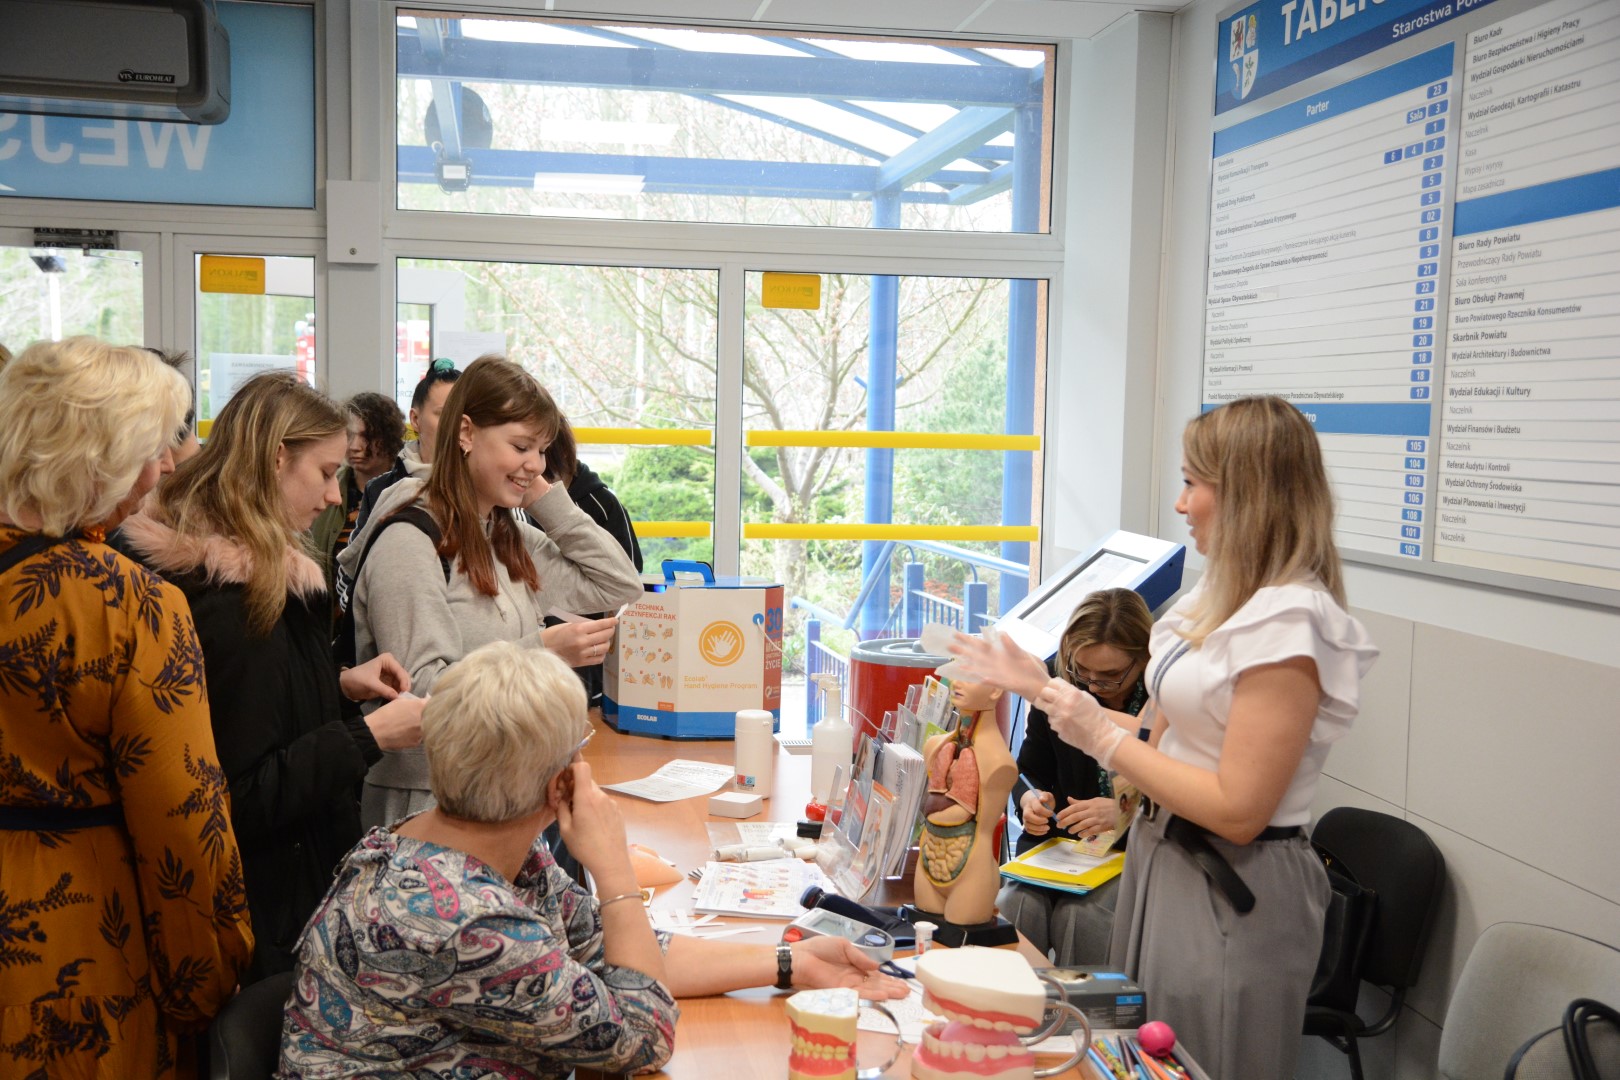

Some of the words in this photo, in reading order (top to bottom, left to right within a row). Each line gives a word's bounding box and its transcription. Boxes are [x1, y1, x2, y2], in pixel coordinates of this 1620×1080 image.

[1392, 4, 1452, 38] Starostwa
[1472, 52, 1487, 64] Biuro
[1488, 35, 1533, 58] Bezpieczeństwa
[1537, 25, 1561, 41] Higieny
[1562, 18, 1580, 31] Pracy
[1473, 33, 1488, 45] Biuro
[1489, 27, 1503, 39] Kadr
[1470, 67, 1491, 83] Wydział
[1492, 55, 1526, 74] Gospodarki
[1433, 85, 1442, 96] 23
[1467, 107, 1489, 121] Wydział
[1517, 87, 1550, 105] Kartografii
[1553, 79, 1581, 94] Katastru
[1306, 100, 1329, 117] Parter
[1409, 110, 1424, 122] Sala
[1433, 140, 1438, 149] 7
[1427, 211, 1435, 221] 02
[1458, 241, 1474, 251] Biuro
[1476, 238, 1491, 249] Rady
[1493, 233, 1520, 245] Powiatu
[1501, 252, 1516, 262] Rady
[1517, 249, 1541, 260] Powiatu
[1424, 265, 1431, 275] 21
[1421, 283, 1429, 292] 22
[1455, 296, 1470, 306] Biuro
[1472, 292, 1496, 304] Obsługi
[1497, 289, 1525, 300] Prawnej
[1421, 300, 1428, 310] 21
[1455, 315, 1469, 324] Biuro
[1470, 312, 1506, 322] Powiatowego
[1507, 308, 1536, 318] Rzecznika
[1537, 304, 1582, 316] Konsumentów
[1419, 318, 1427, 328] 19
[1418, 336, 1427, 345] 20
[1453, 331, 1479, 342] Skarbnik
[1481, 330, 1507, 340] Powiatu
[1419, 353, 1426, 362] 18
[1473, 349, 1506, 359] Architektury
[1511, 347, 1551, 357] Budownictwa
[1417, 371, 1424, 380] 18
[1416, 388, 1424, 398] 17
[1449, 387, 1473, 398] Wydział
[1474, 386, 1501, 397] Edukacji
[1505, 386, 1531, 397] Kultury
[1447, 424, 1467, 434] Wydział
[1468, 424, 1493, 433] Finansów
[1497, 425, 1520, 434] Budżetu
[1411, 441, 1421, 451] 105
[1410, 459, 1420, 469] 104
[1447, 460, 1465, 469] Referat
[1466, 461, 1484, 471] Audytu
[1488, 463, 1510, 472] Kontroli
[1409, 476, 1420, 486] 109
[1445, 478, 1465, 488] Wydział
[1466, 479, 1489, 491] Ochrony
[1489, 479, 1522, 492] Środowiska
[1443, 496, 1462, 506] Wydział
[1463, 497, 1493, 509] Planowania
[1497, 501, 1526, 514] Inwestycji
[1407, 510, 1418, 520] 108
[1405, 527, 1416, 537] 101
[1405, 545, 1415, 555] 102
[635, 603, 664, 612] TECHNIKA
[766, 607, 782, 632] 30
